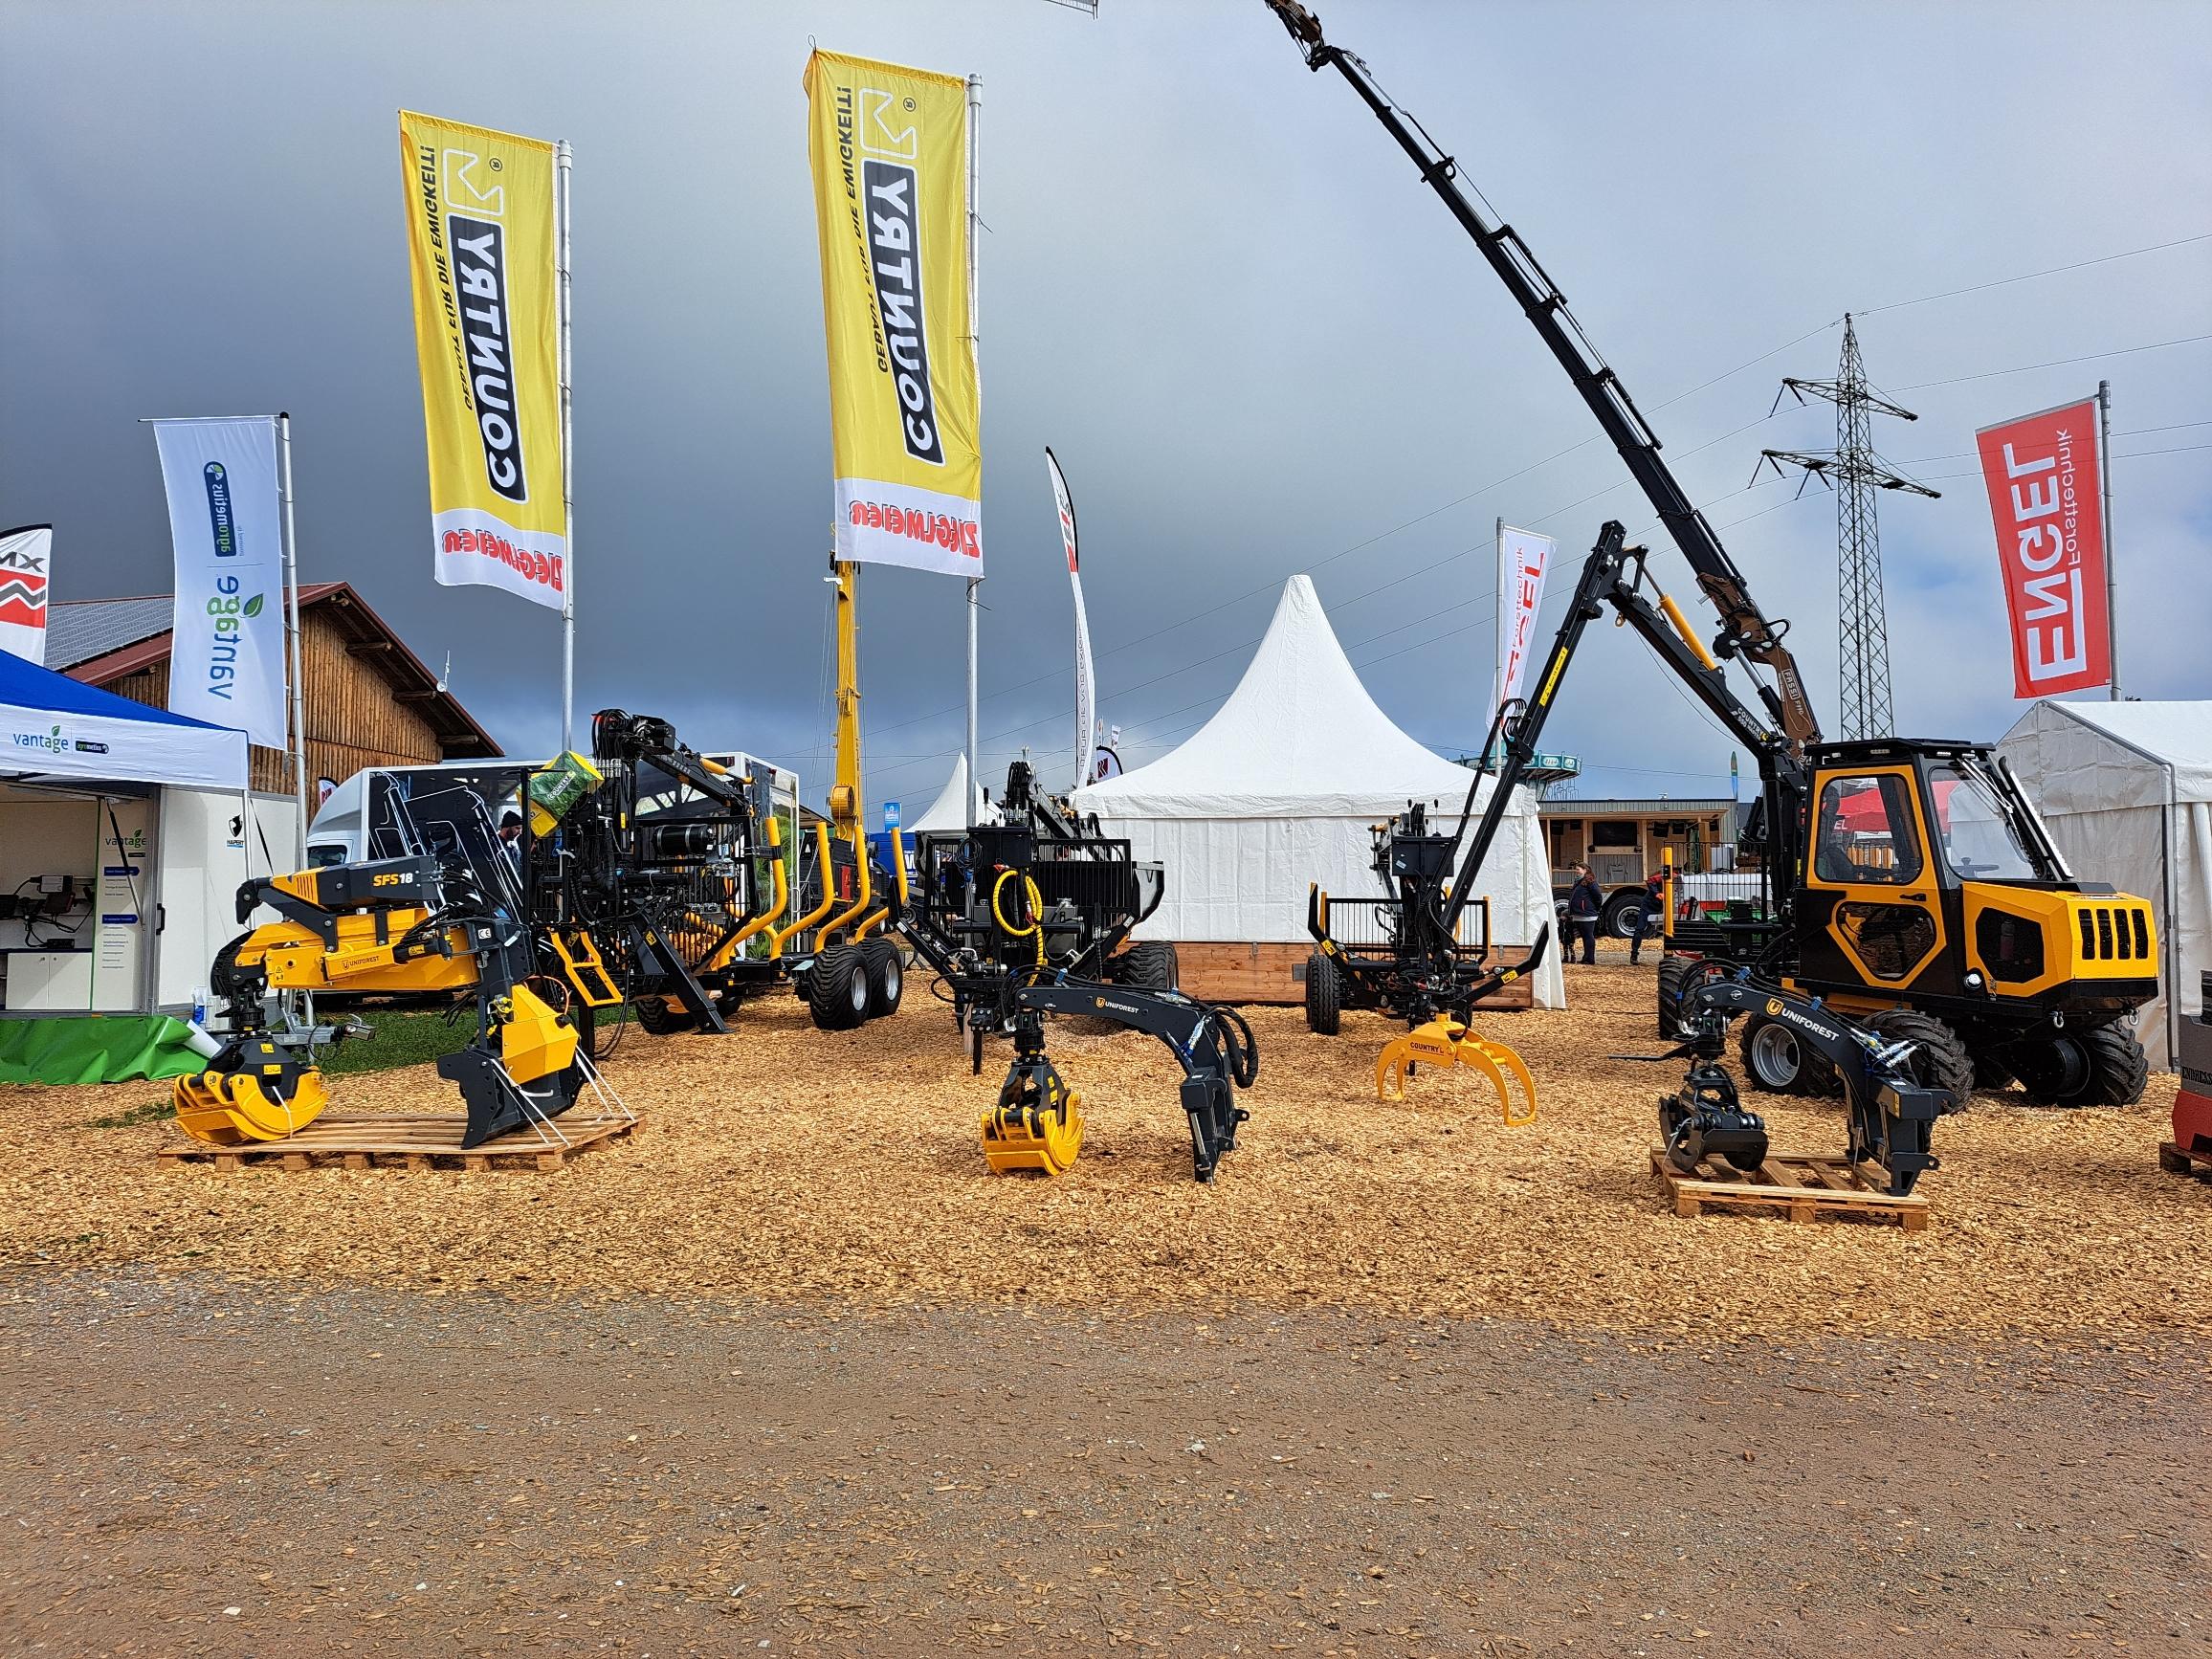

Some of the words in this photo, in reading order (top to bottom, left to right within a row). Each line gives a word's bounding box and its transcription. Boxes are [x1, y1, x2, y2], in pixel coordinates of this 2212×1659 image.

[1737, 707, 1764, 735] COUNTRY
[13, 733, 69, 753] vantage
[350, 956, 380, 966] UNIFOREST
[1105, 1001, 1139, 1014] UNIFOREST
[1781, 1007, 1840, 1041] UNIFOREST
[1409, 1041, 1439, 1053] COUNTRY
